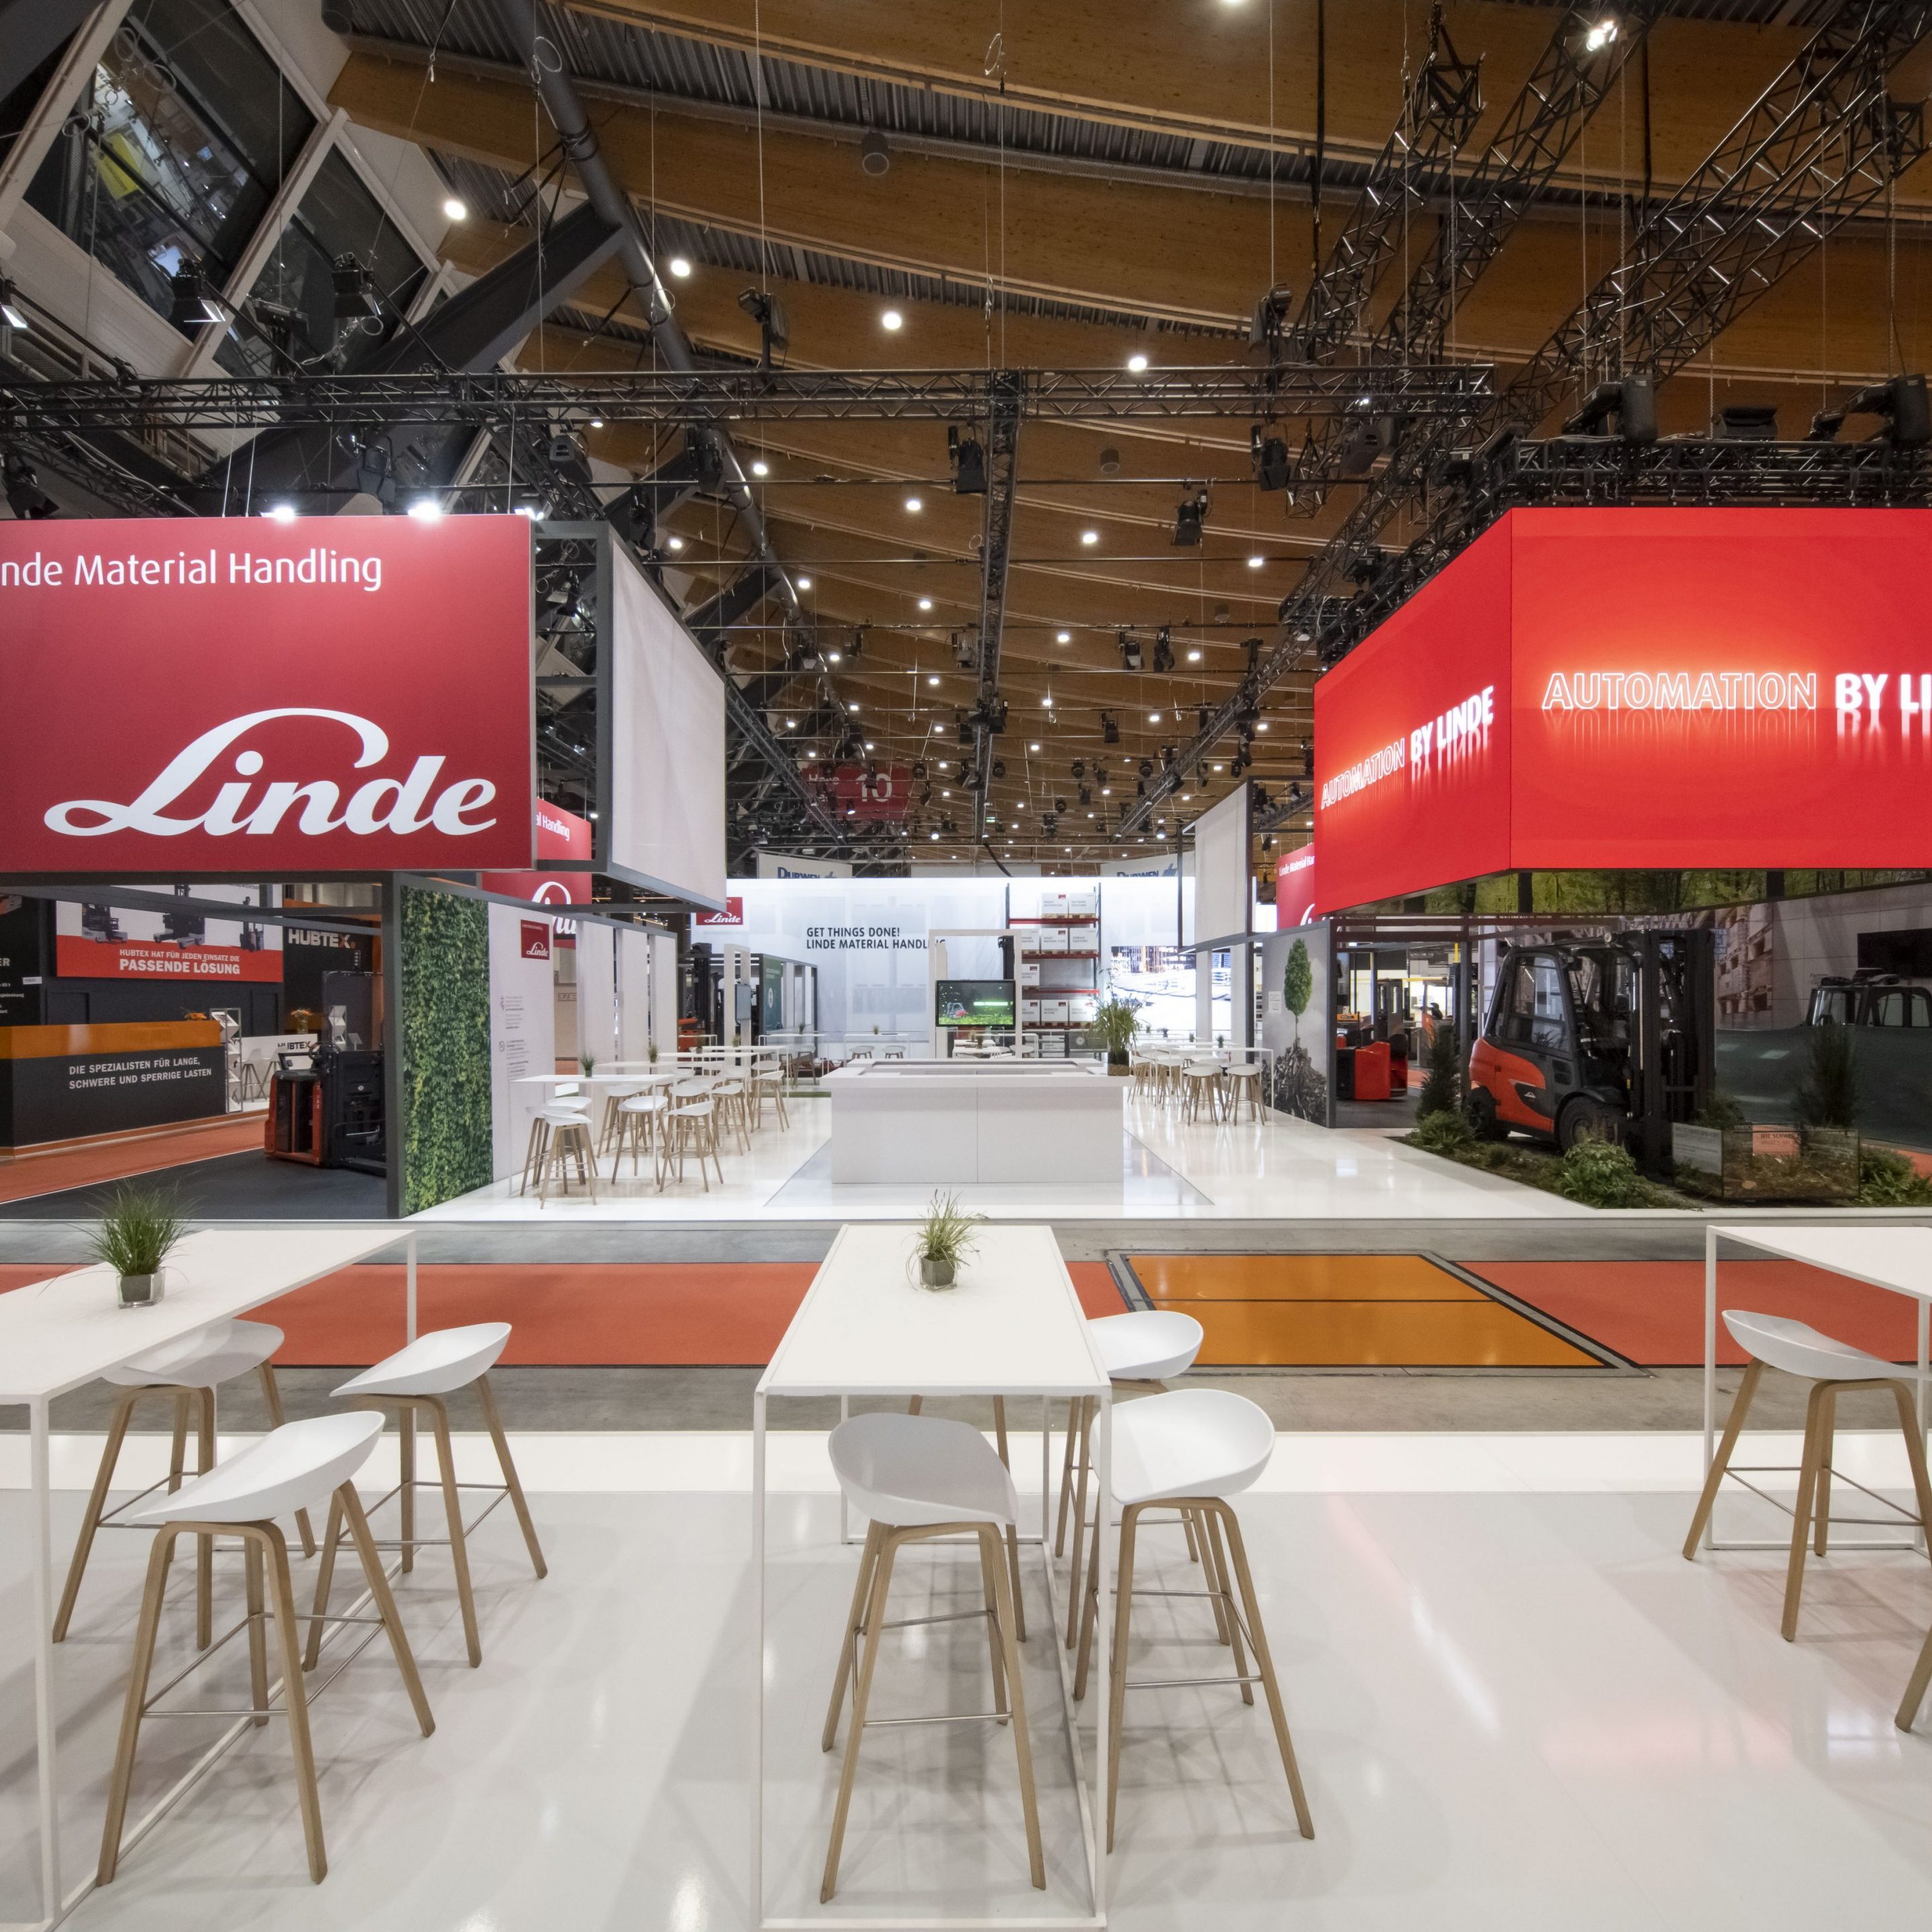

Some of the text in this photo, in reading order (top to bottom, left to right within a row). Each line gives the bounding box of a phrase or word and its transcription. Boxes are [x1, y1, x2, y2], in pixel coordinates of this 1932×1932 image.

[74, 549, 217, 586] Material
[229, 548, 382, 592] Handling
[1542, 672, 1817, 710] AUTOMATION
[1835, 673, 1889, 710] BY
[1321, 685, 1494, 810] AUTOMATION BY LINDE
[44, 708, 497, 837] Linde
[855, 773, 892, 802] 10
[543, 814, 570, 841] Handling
[704, 912, 741, 923] Linde
[288, 928, 351, 949] HUBTEX
[807, 927, 900, 937] GET THINGS DONE!
[526, 942, 549, 957] Linde
[806, 939, 836, 949] LINDE
[839, 939, 890, 949] MATERIAL
[119, 949, 149, 957] HUBTEX
[166, 951, 180, 959] FÜR
[203, 953, 228, 962] EINSATZ
[119, 959, 240, 975] PASSENDE LÖSUNG
[69, 1057, 200, 1075] DIE SPEZIALISTEN FÜR LANGE,
[69, 1068, 212, 1089] SCHWERE UND SPERRIGE LASTEN
